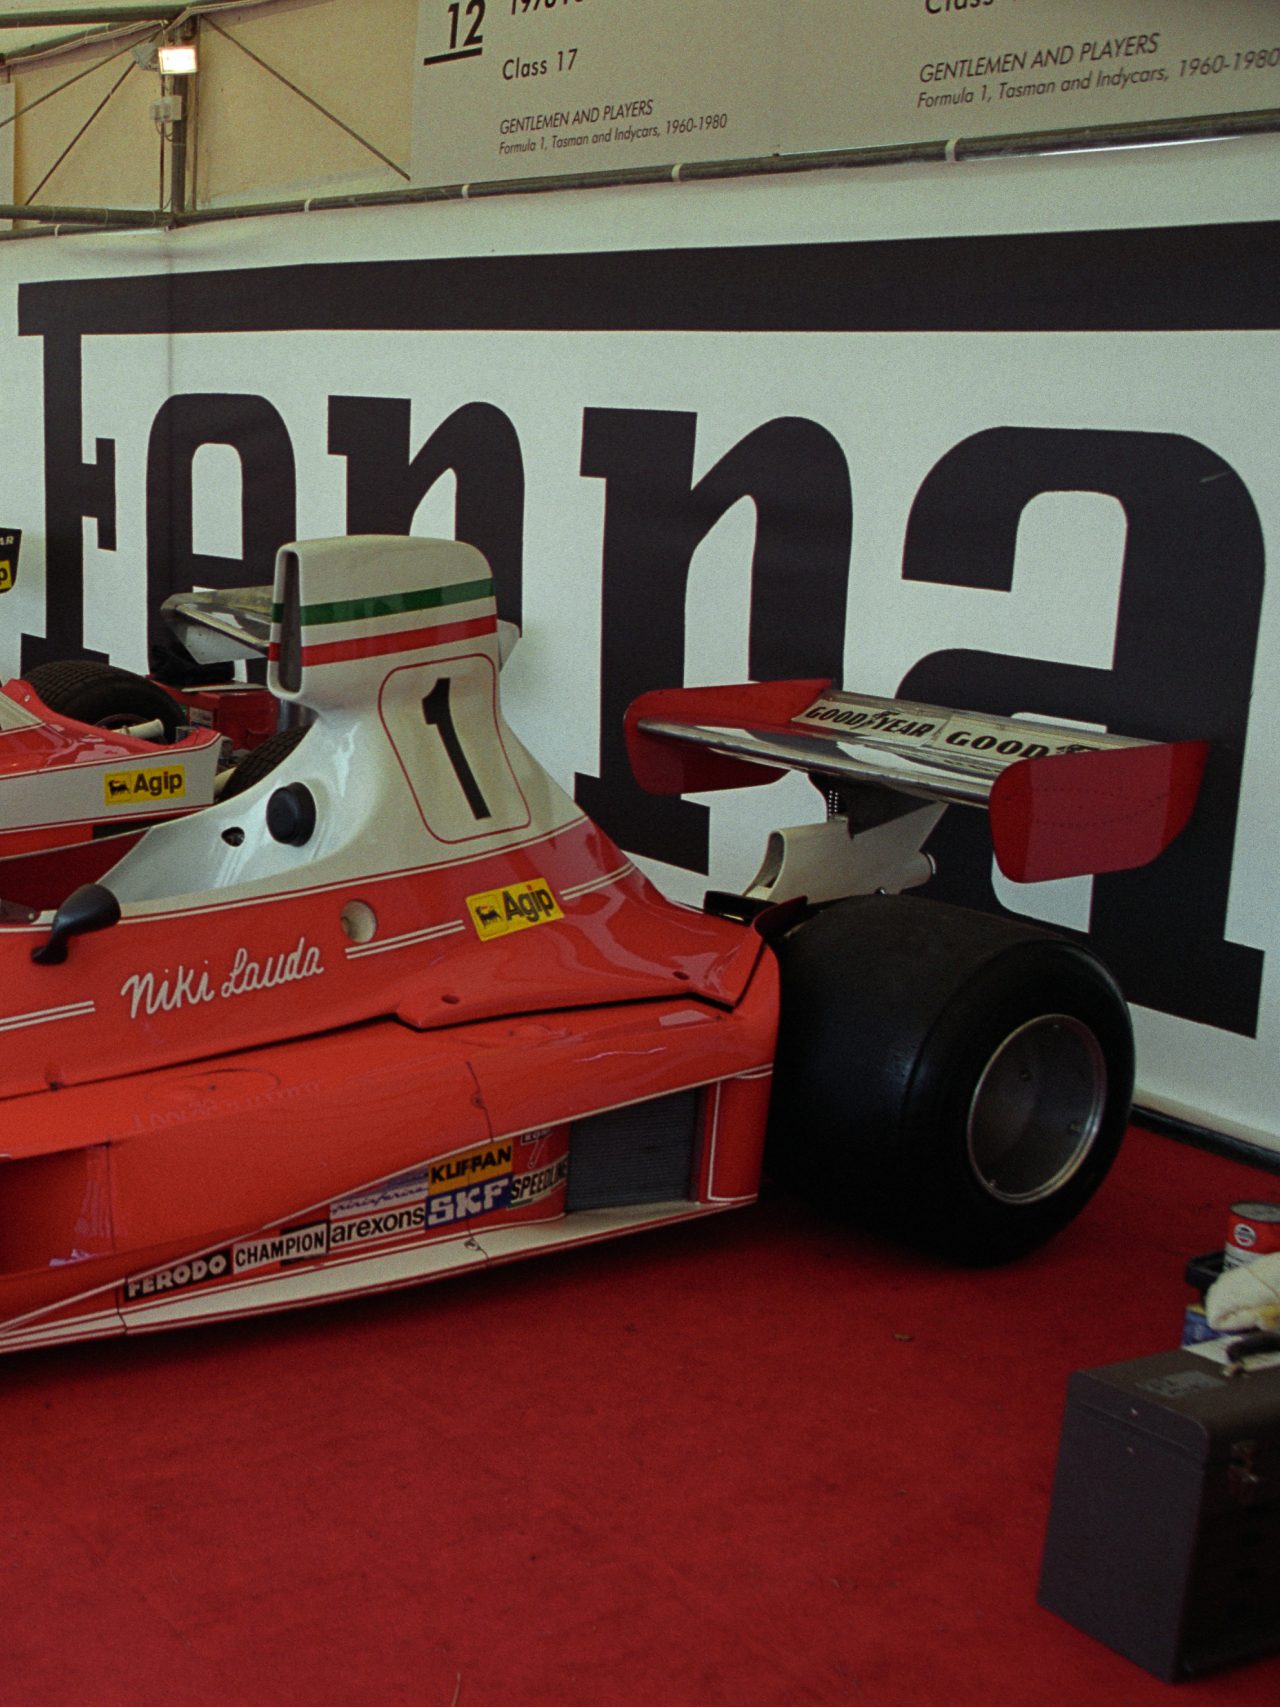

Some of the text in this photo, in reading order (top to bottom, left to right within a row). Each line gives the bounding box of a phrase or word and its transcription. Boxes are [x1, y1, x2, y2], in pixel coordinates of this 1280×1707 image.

[447, 0, 486, 49] 12
[502, 48, 578, 80] Class 17
[917, 47, 1280, 108] Formula 1, Tasman and Indycars, 1960-1980
[920, 33, 1161, 83] GENTLEMEN AND PLAYERS
[499, 113, 728, 155] Formula 1, Tasman and Indycars, 1960-1980
[500, 99, 653, 135] GENTLEMEN AND PLAYERS
[805, 706, 936, 738] GOODYEAR
[420, 676, 493, 821] 1
[133, 770, 182, 796] Agip
[502, 884, 554, 922] Agip
[120, 936, 325, 1020] Niki Lauda
[427, 1178, 509, 1226] SKF
[332, 1206, 425, 1244] arexons
[234, 1230, 325, 1268] CHAMPION
[128, 1253, 227, 1298] FERODO
